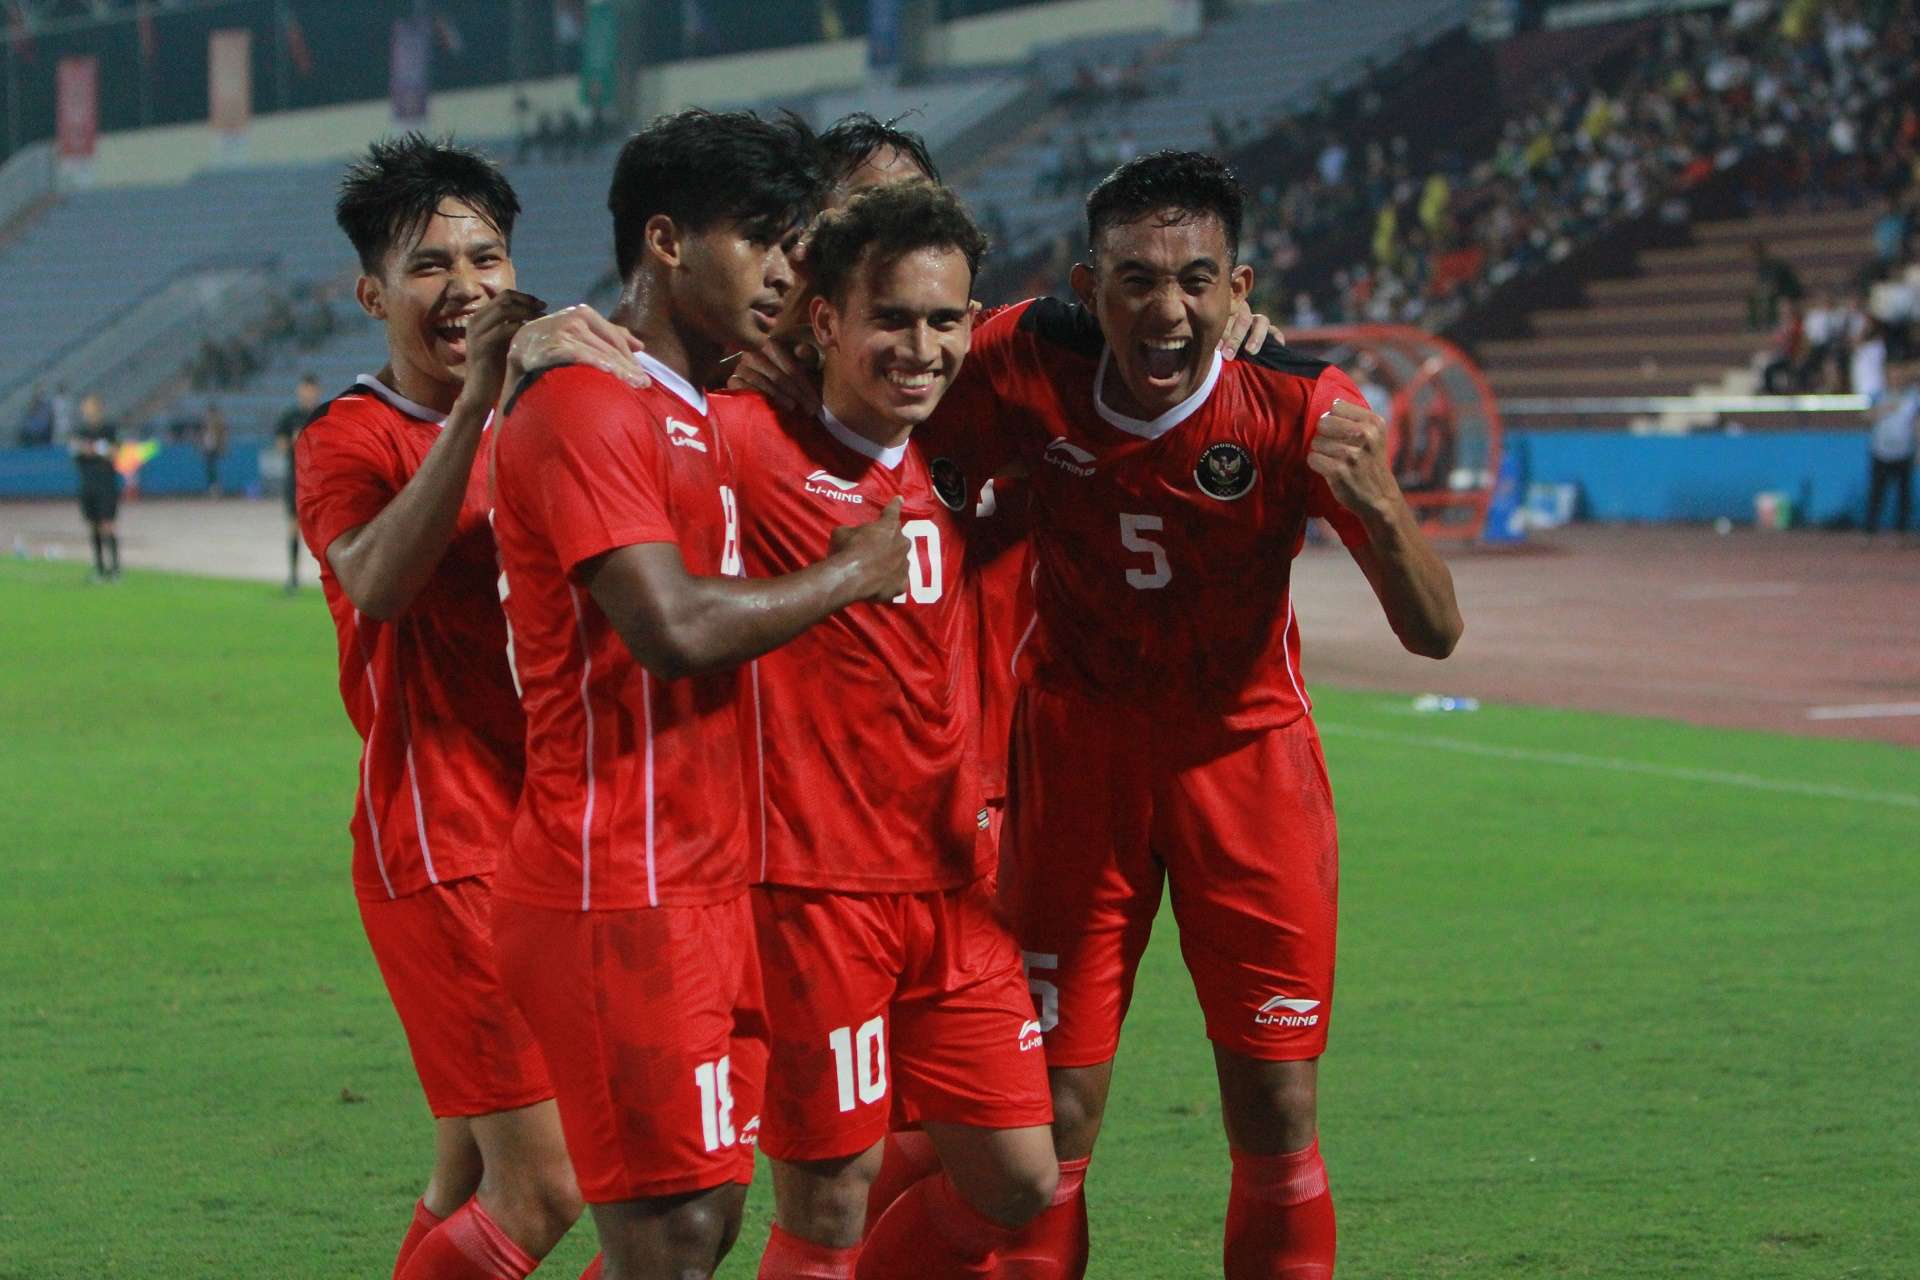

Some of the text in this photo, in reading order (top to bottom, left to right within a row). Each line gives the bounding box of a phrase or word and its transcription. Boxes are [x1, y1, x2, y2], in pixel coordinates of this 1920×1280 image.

[804, 481, 863, 504] LI-NING
[1043, 451, 1097, 478] LI-NING
[893, 519, 942, 604] 0
[1119, 512, 1173, 590] 5
[1021, 950, 1059, 1032] 5
[1254, 1013, 1319, 1027] LI-NING
[829, 1014, 887, 1113] 10
